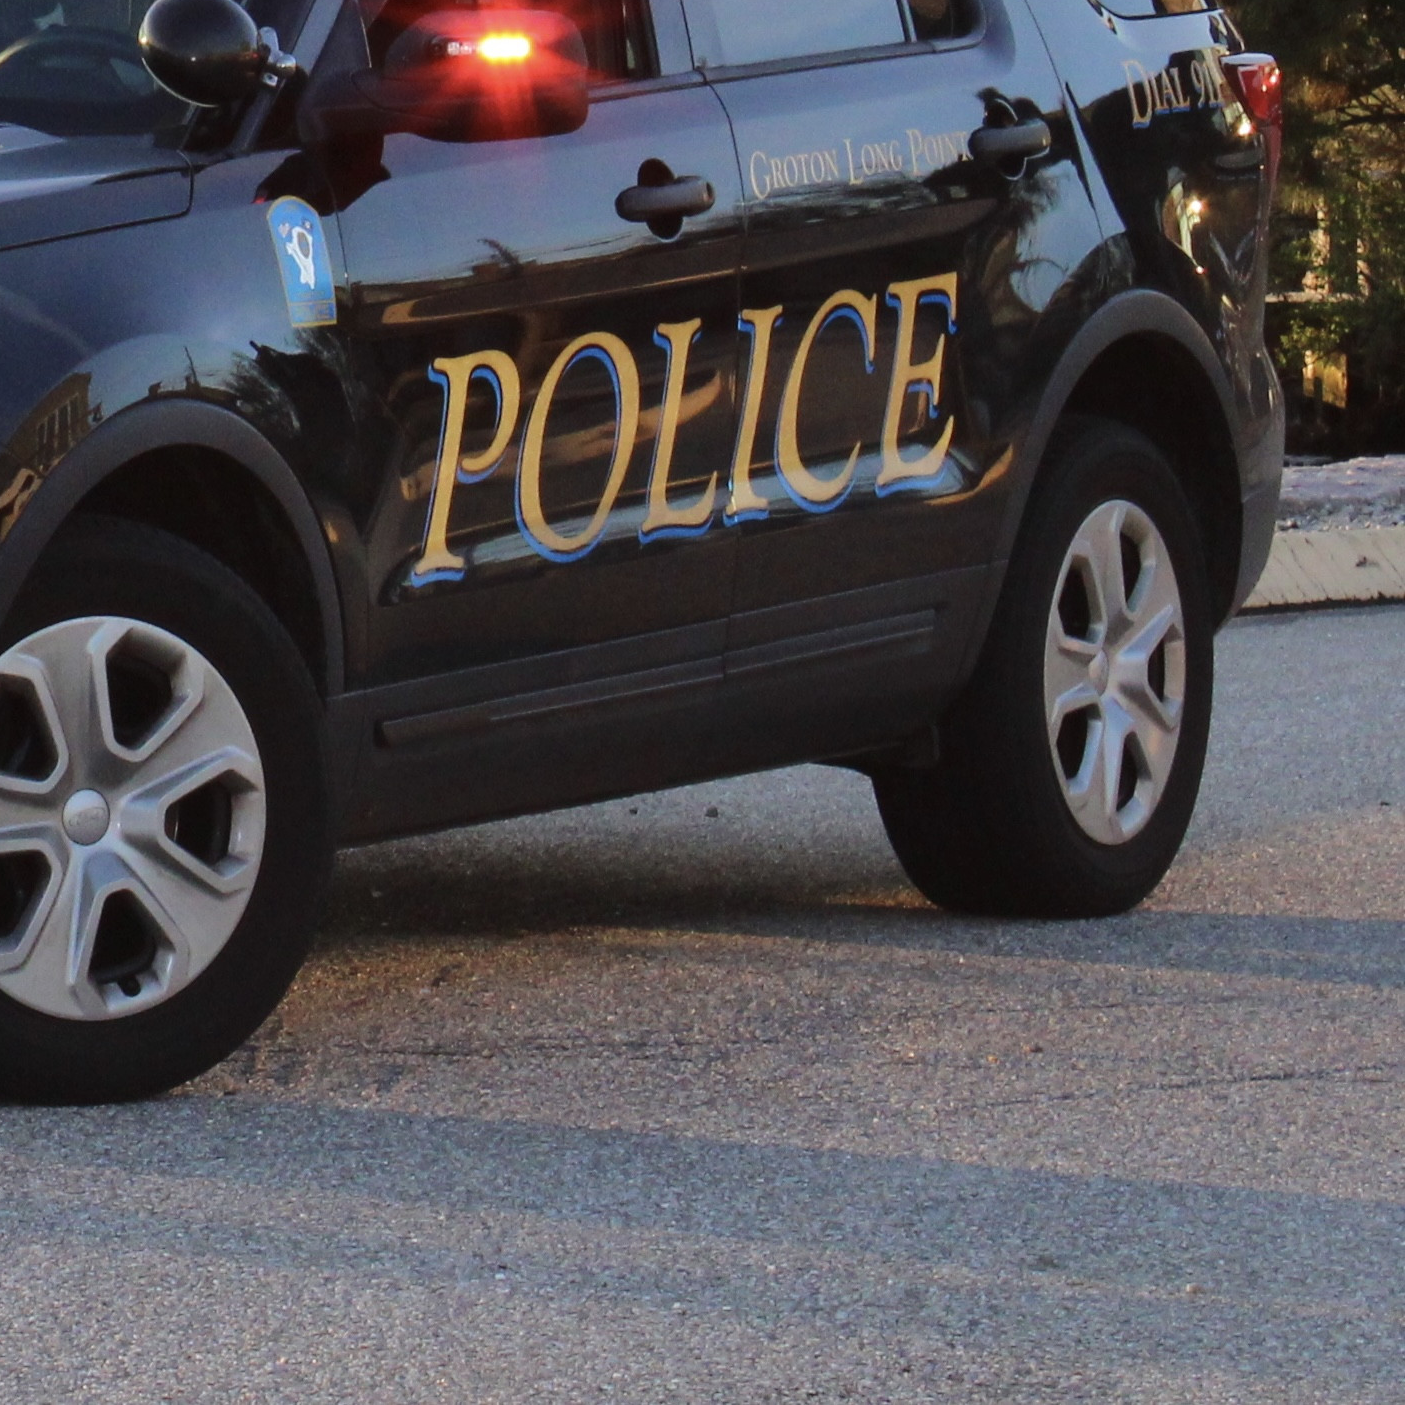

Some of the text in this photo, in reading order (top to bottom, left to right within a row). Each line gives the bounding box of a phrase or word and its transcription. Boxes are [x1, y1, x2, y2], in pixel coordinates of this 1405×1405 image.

[1122, 59, 1190, 128] DIAL
[750, 129, 972, 200] GROTON LONG POINT
[411, 272, 958, 588] POLICE
